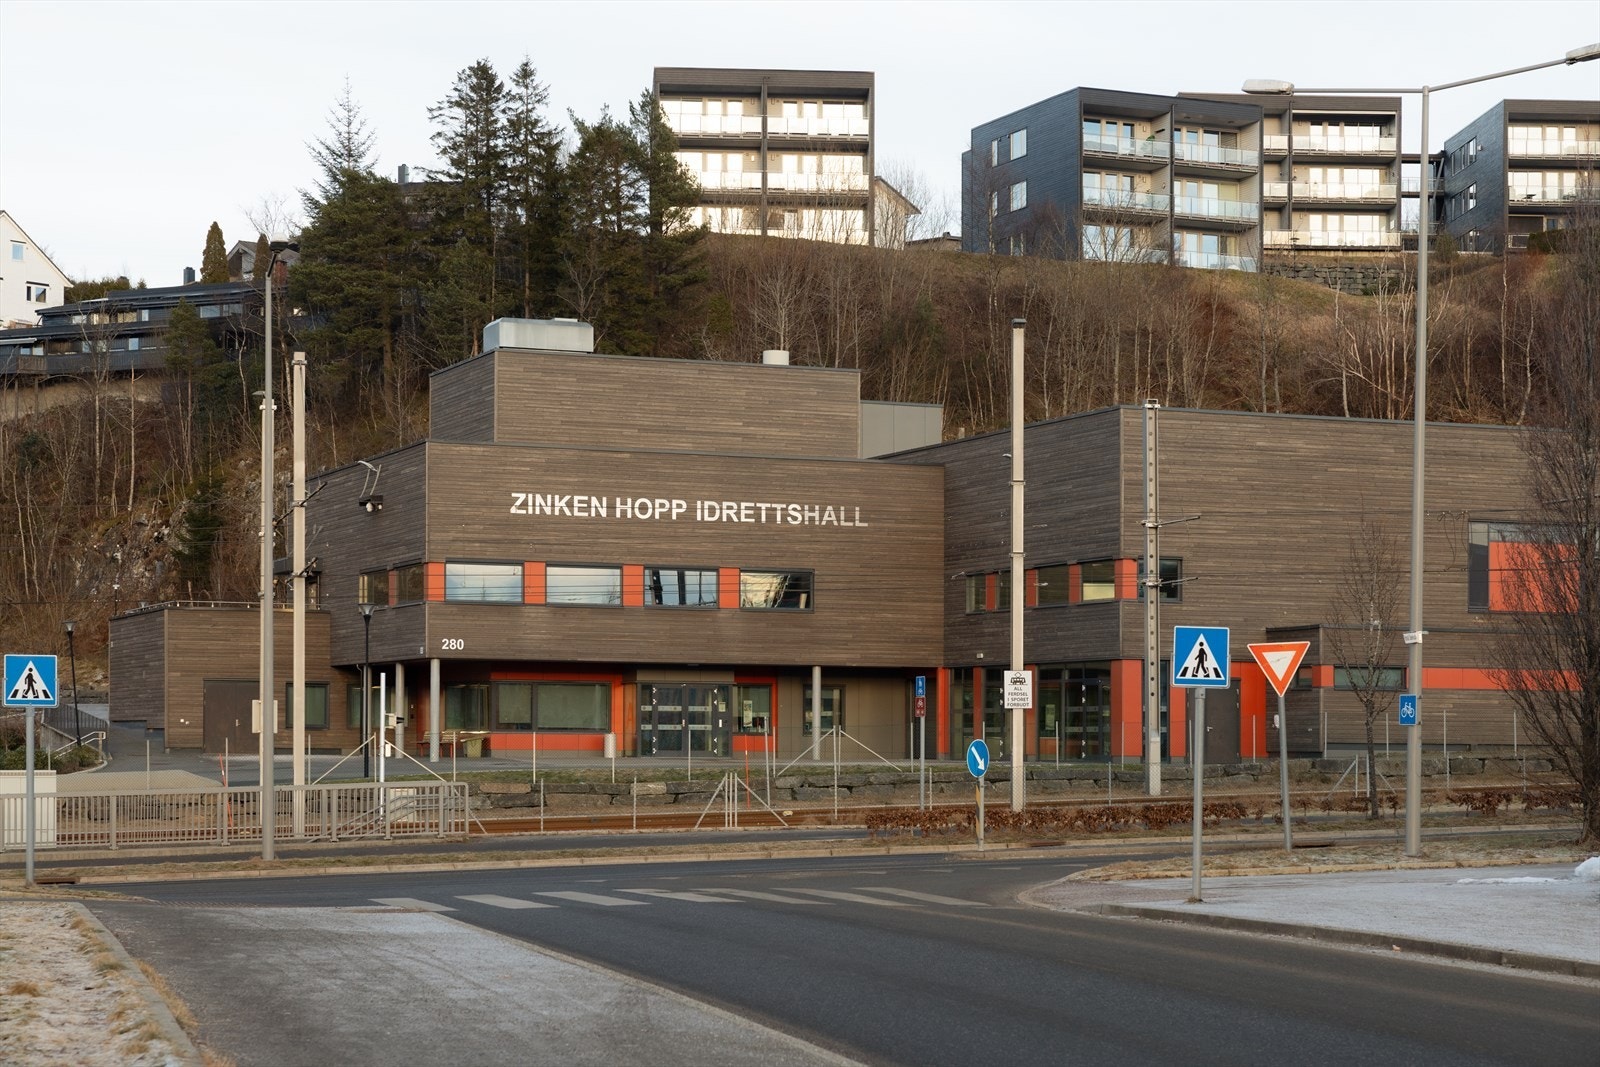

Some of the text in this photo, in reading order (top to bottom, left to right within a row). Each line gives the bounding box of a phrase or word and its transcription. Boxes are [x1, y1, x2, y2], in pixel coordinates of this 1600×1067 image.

[509, 492, 869, 527] ZINKEN HOPP IDRETTSHALL
[441, 638, 465, 651] 280
